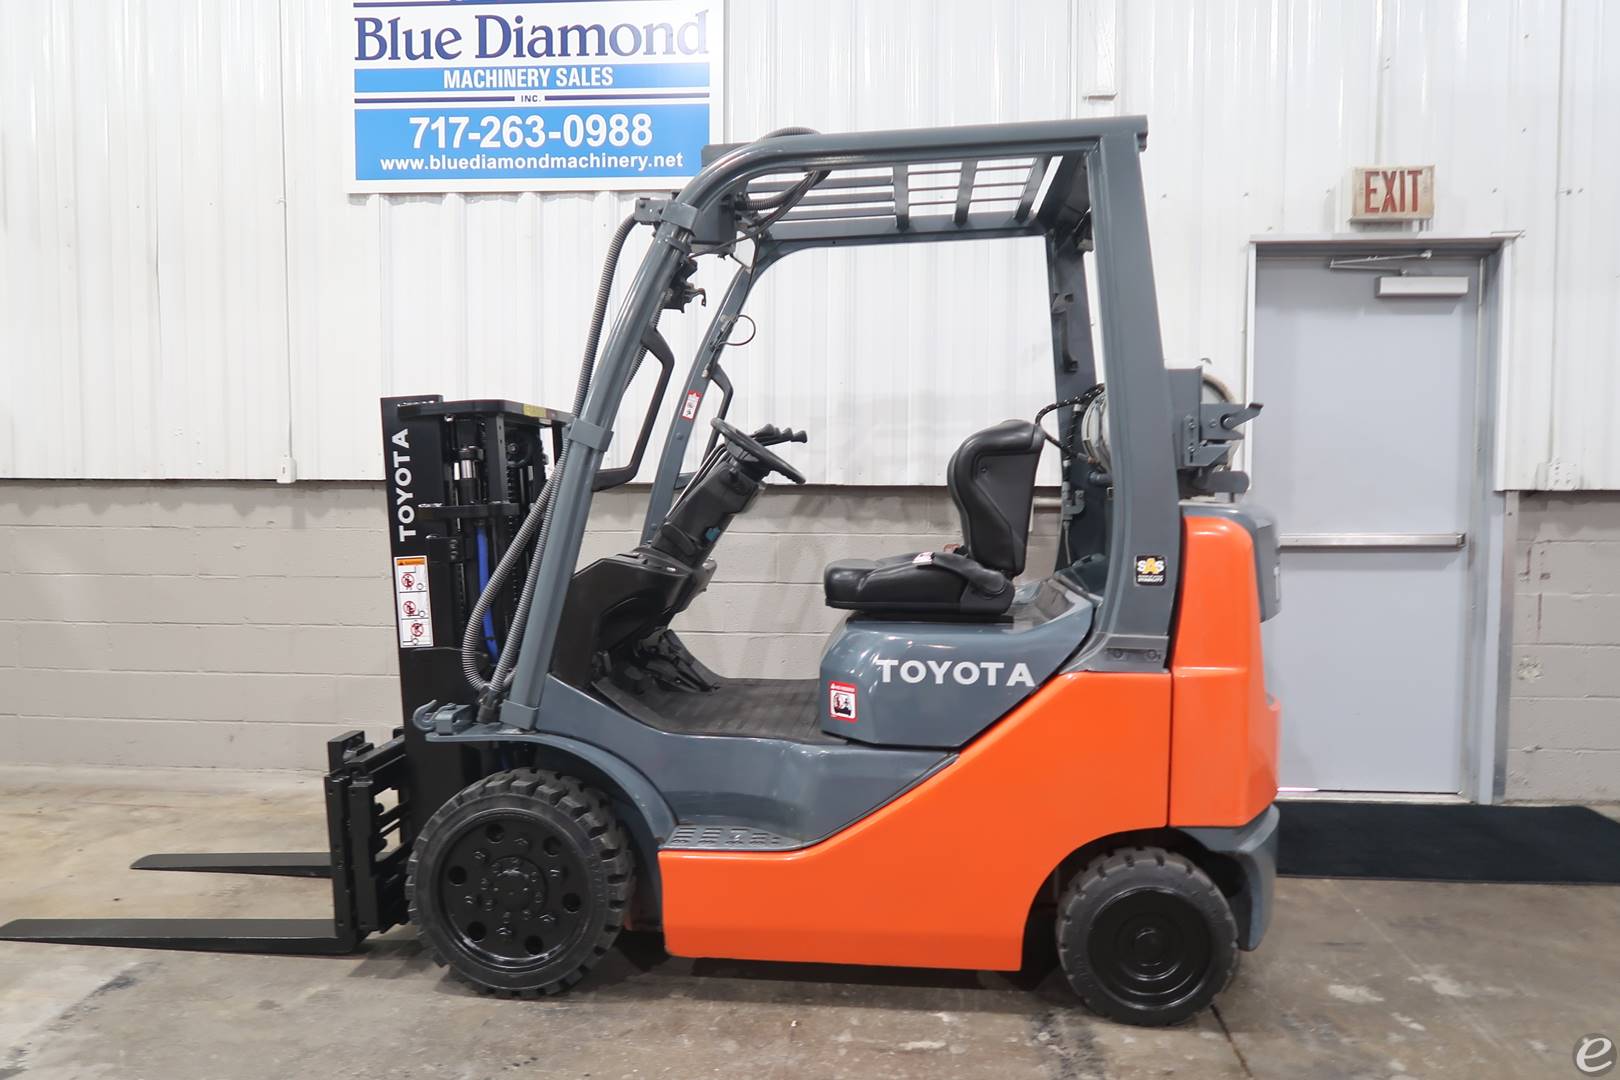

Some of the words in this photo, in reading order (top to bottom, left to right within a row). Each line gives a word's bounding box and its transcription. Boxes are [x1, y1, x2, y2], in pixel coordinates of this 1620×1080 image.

[354, 17, 462, 61] Blue
[475, 9, 709, 59] Diamond
[443, 68, 550, 89] MACHINERY
[556, 66, 614, 87] SALES
[521, 94, 541, 103] INC.
[409, 114, 653, 149] 717-263-0988
[380, 152, 683, 173] www.bluediamondmachinery.net
[1364, 170, 1423, 213] EXIT
[391, 428, 417, 542] TOYOTA
[875, 659, 1036, 687] TOYOTA
